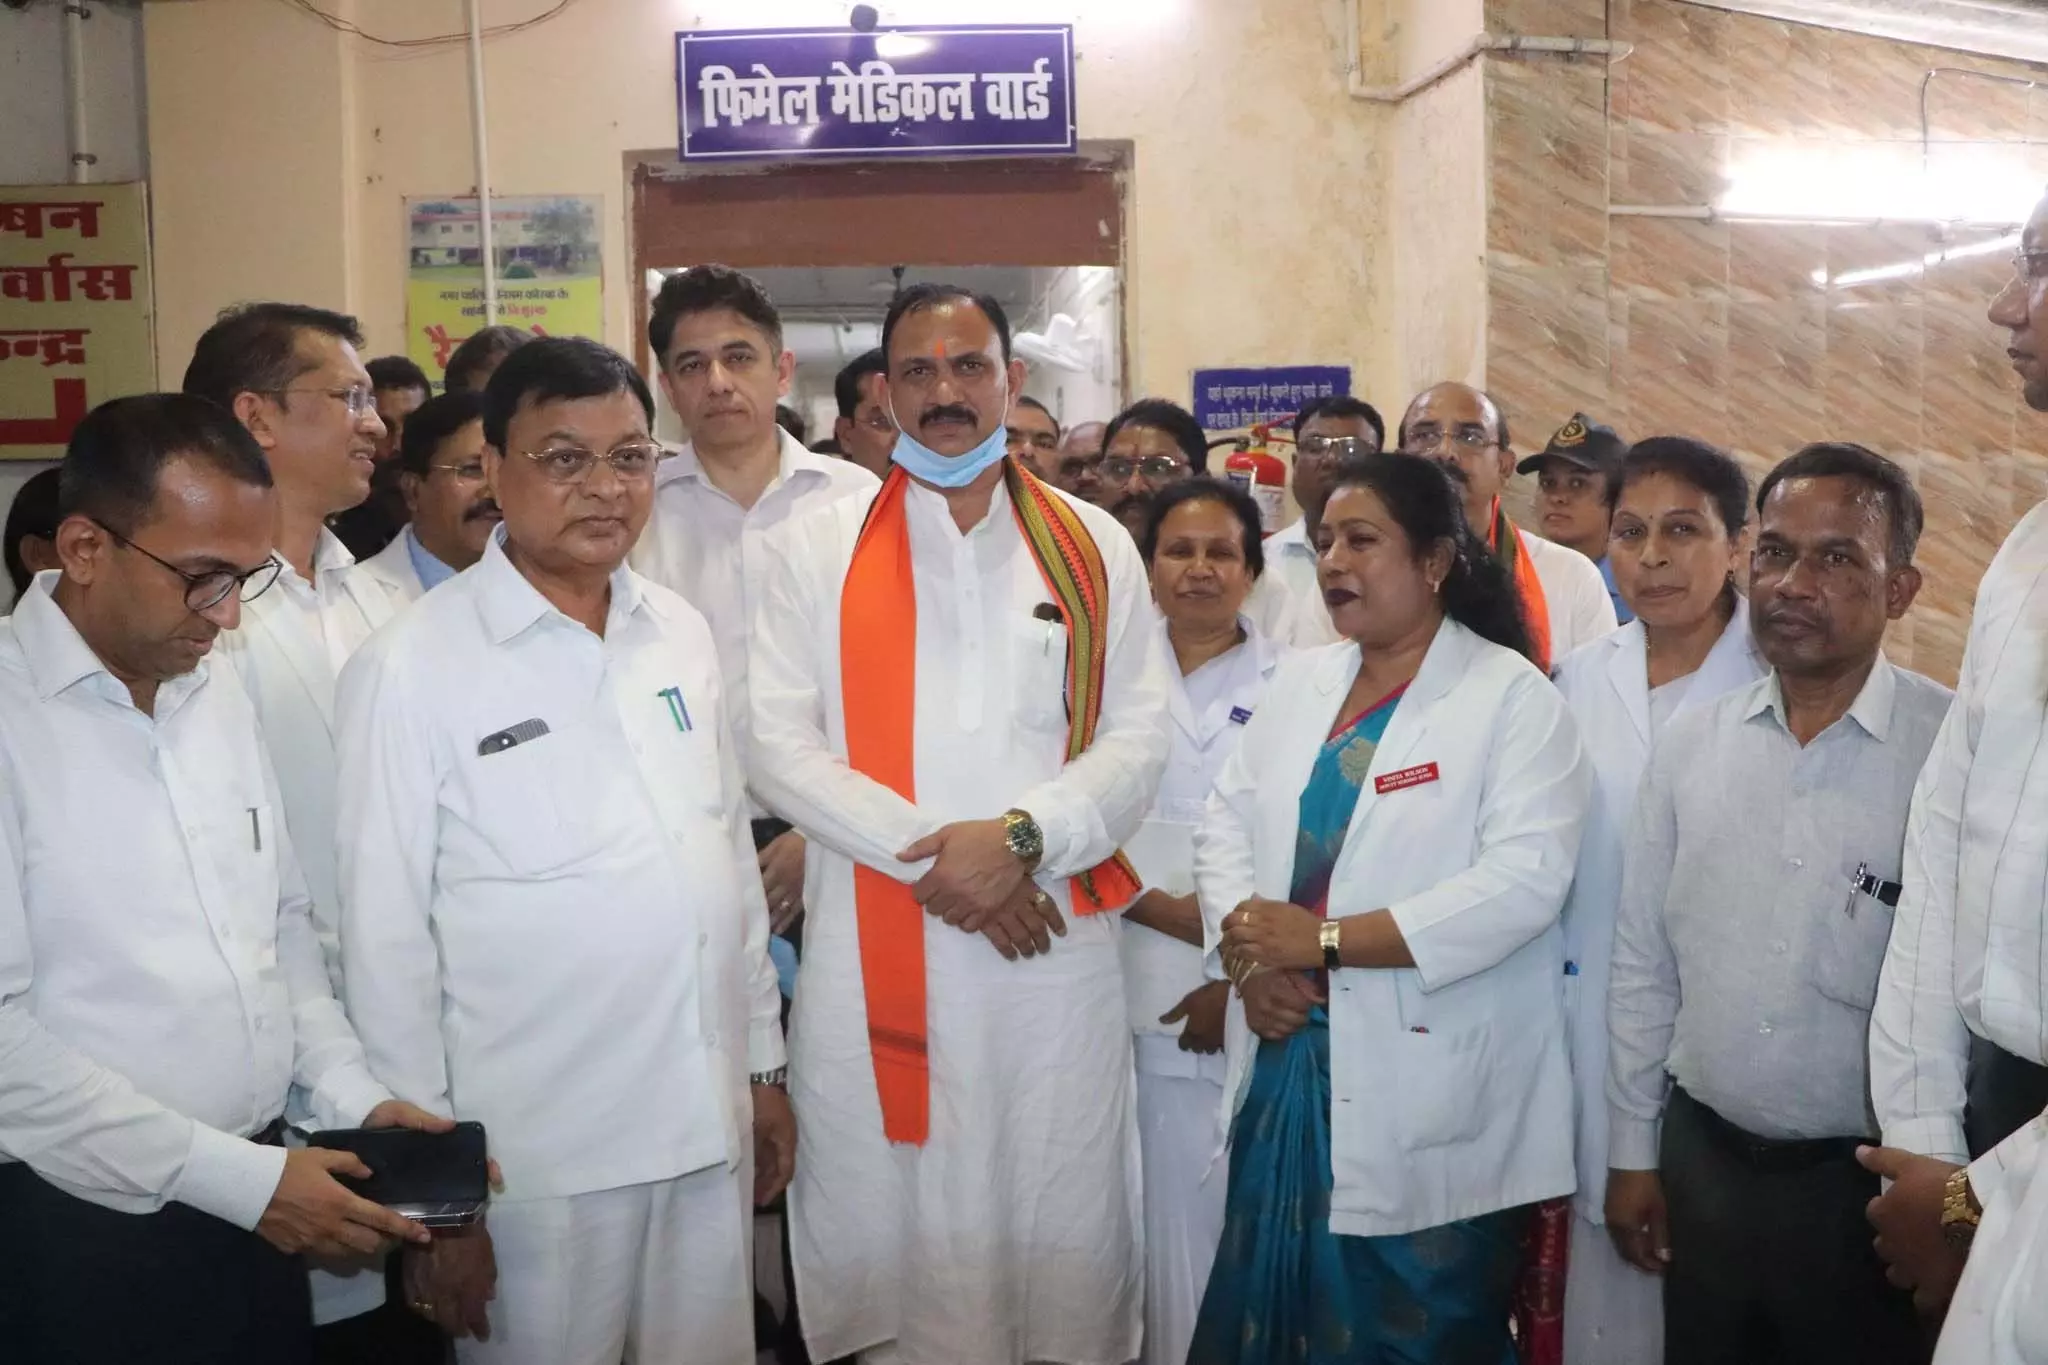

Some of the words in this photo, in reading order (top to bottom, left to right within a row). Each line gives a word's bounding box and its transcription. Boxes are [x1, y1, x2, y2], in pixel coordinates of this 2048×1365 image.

[698, 64, 822, 128] फिमेल
[826, 61, 976, 123] मेडिकल
[981, 58, 1053, 121] वार्ड
